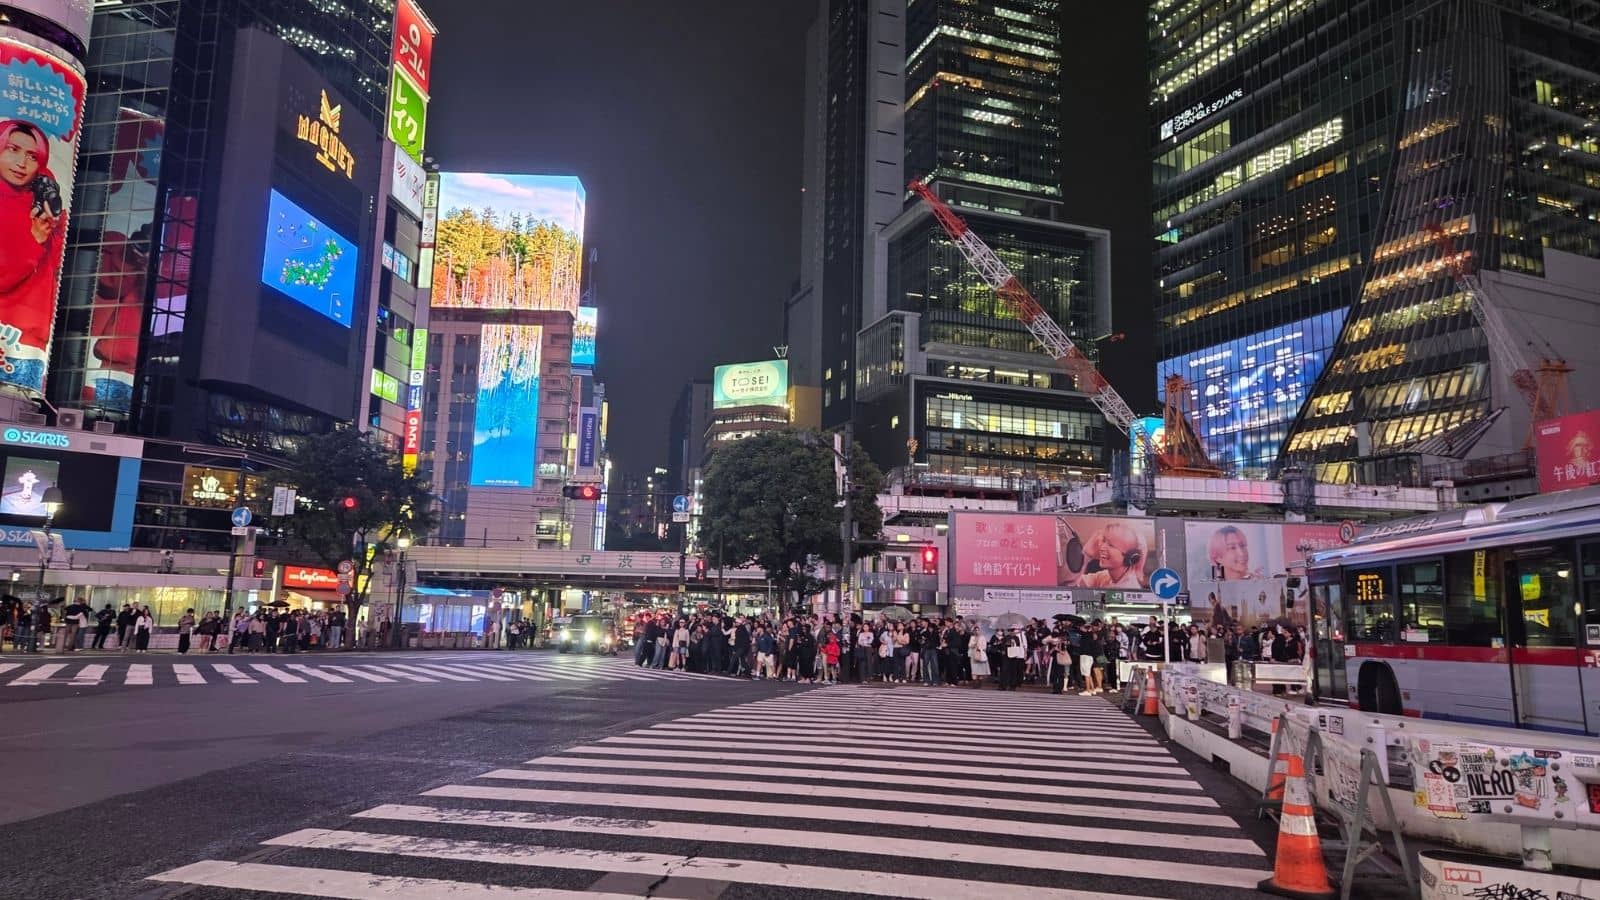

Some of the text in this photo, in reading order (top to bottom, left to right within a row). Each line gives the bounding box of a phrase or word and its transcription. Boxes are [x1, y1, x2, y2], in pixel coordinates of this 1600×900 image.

[8, 73, 65, 101] 新しいこと
[394, 79, 417, 141] レイク
[1211, 88, 1243, 112] SQUARE
[16, 105, 59, 126] メルカリ
[21, 431, 70, 448] STARTS
[1553, 460, 1600, 481] 午後の紅
[576, 554, 591, 565] JR
[1467, 770, 1515, 796] NERO
